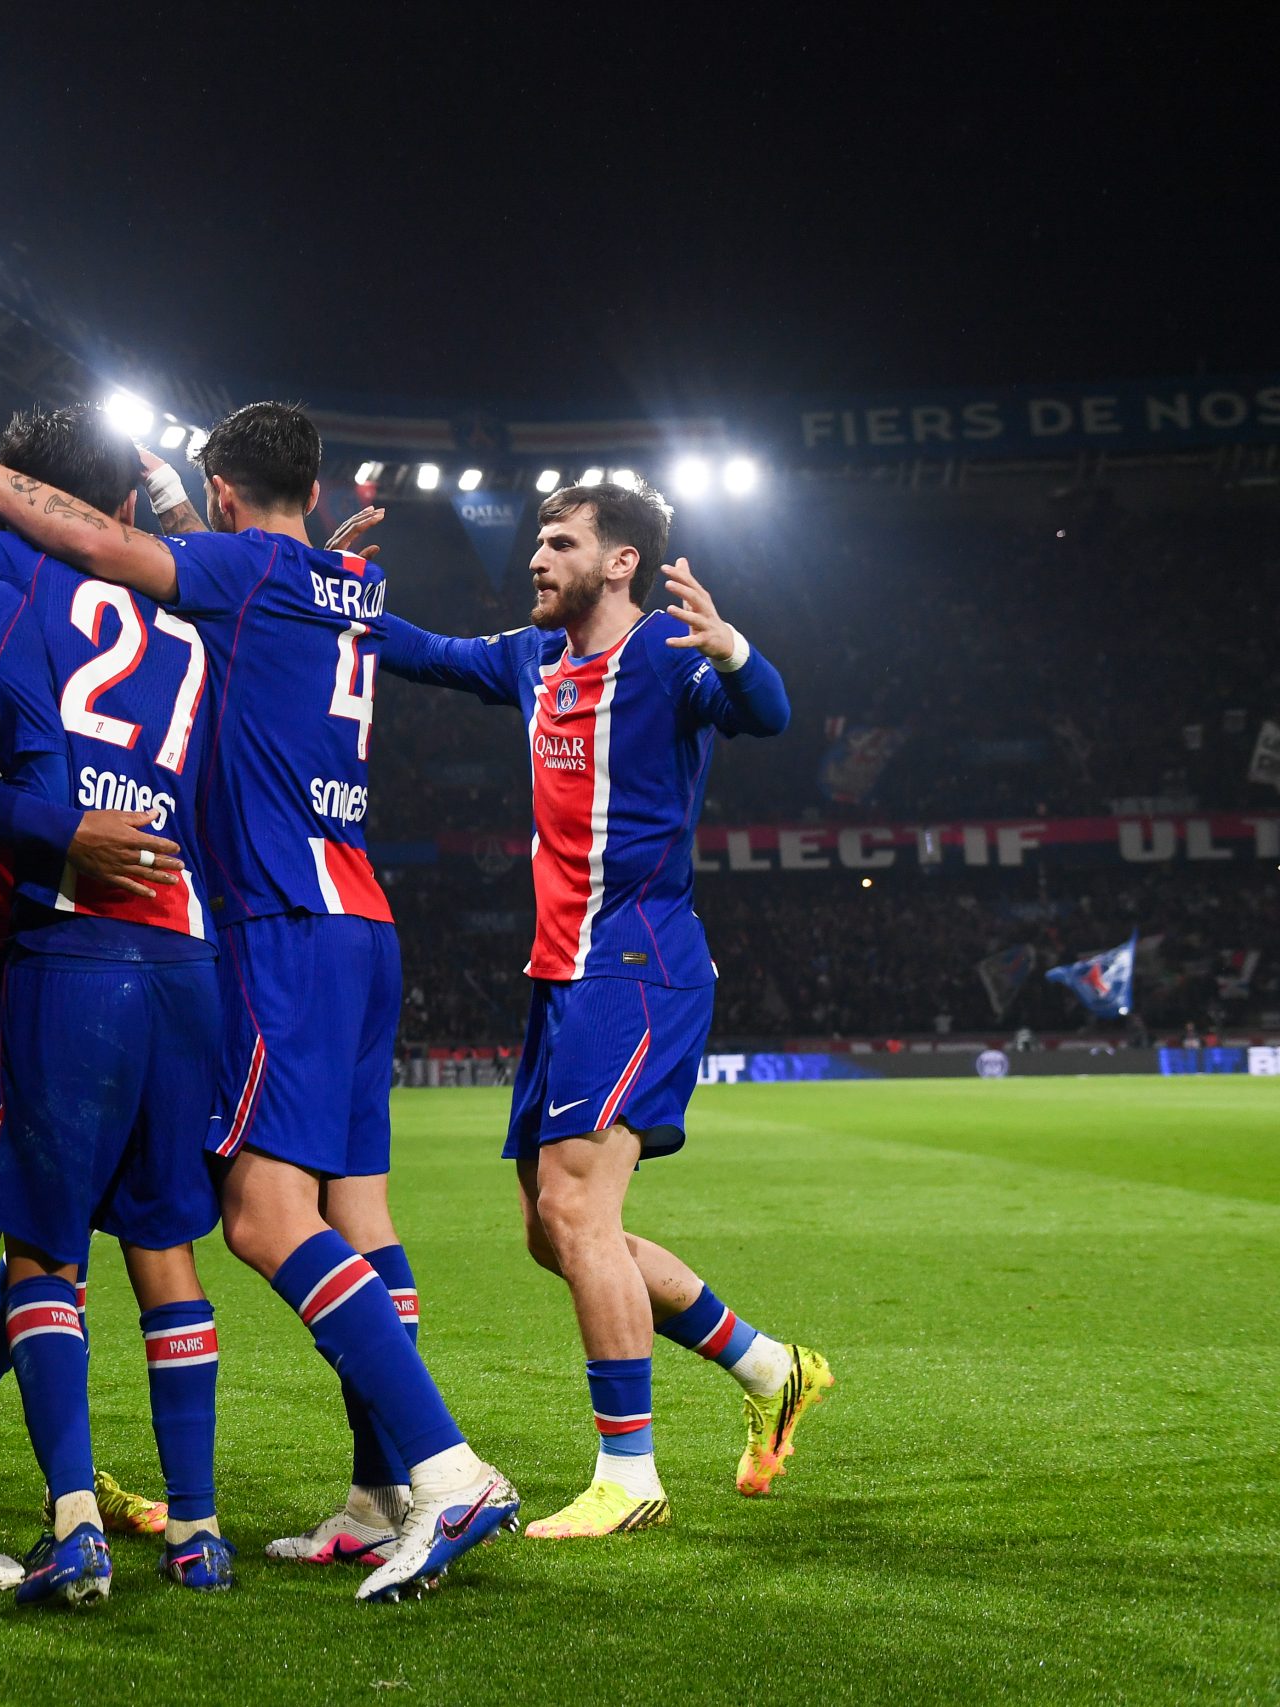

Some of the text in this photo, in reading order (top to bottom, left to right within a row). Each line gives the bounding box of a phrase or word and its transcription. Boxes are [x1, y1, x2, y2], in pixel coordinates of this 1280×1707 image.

[801, 403, 1005, 449] FIERS
[1028, 397, 1123, 436] DE
[60, 579, 208, 775] 27
[329, 620, 373, 761] 4
[535, 735, 586, 758] QATAR
[543, 758, 587, 771] AIRWAYS
[310, 777, 368, 828] snipes
[696, 1053, 746, 1084] UT
[393, 1299, 415, 1312] ARIS
[169, 1336, 204, 1354] PARIS
